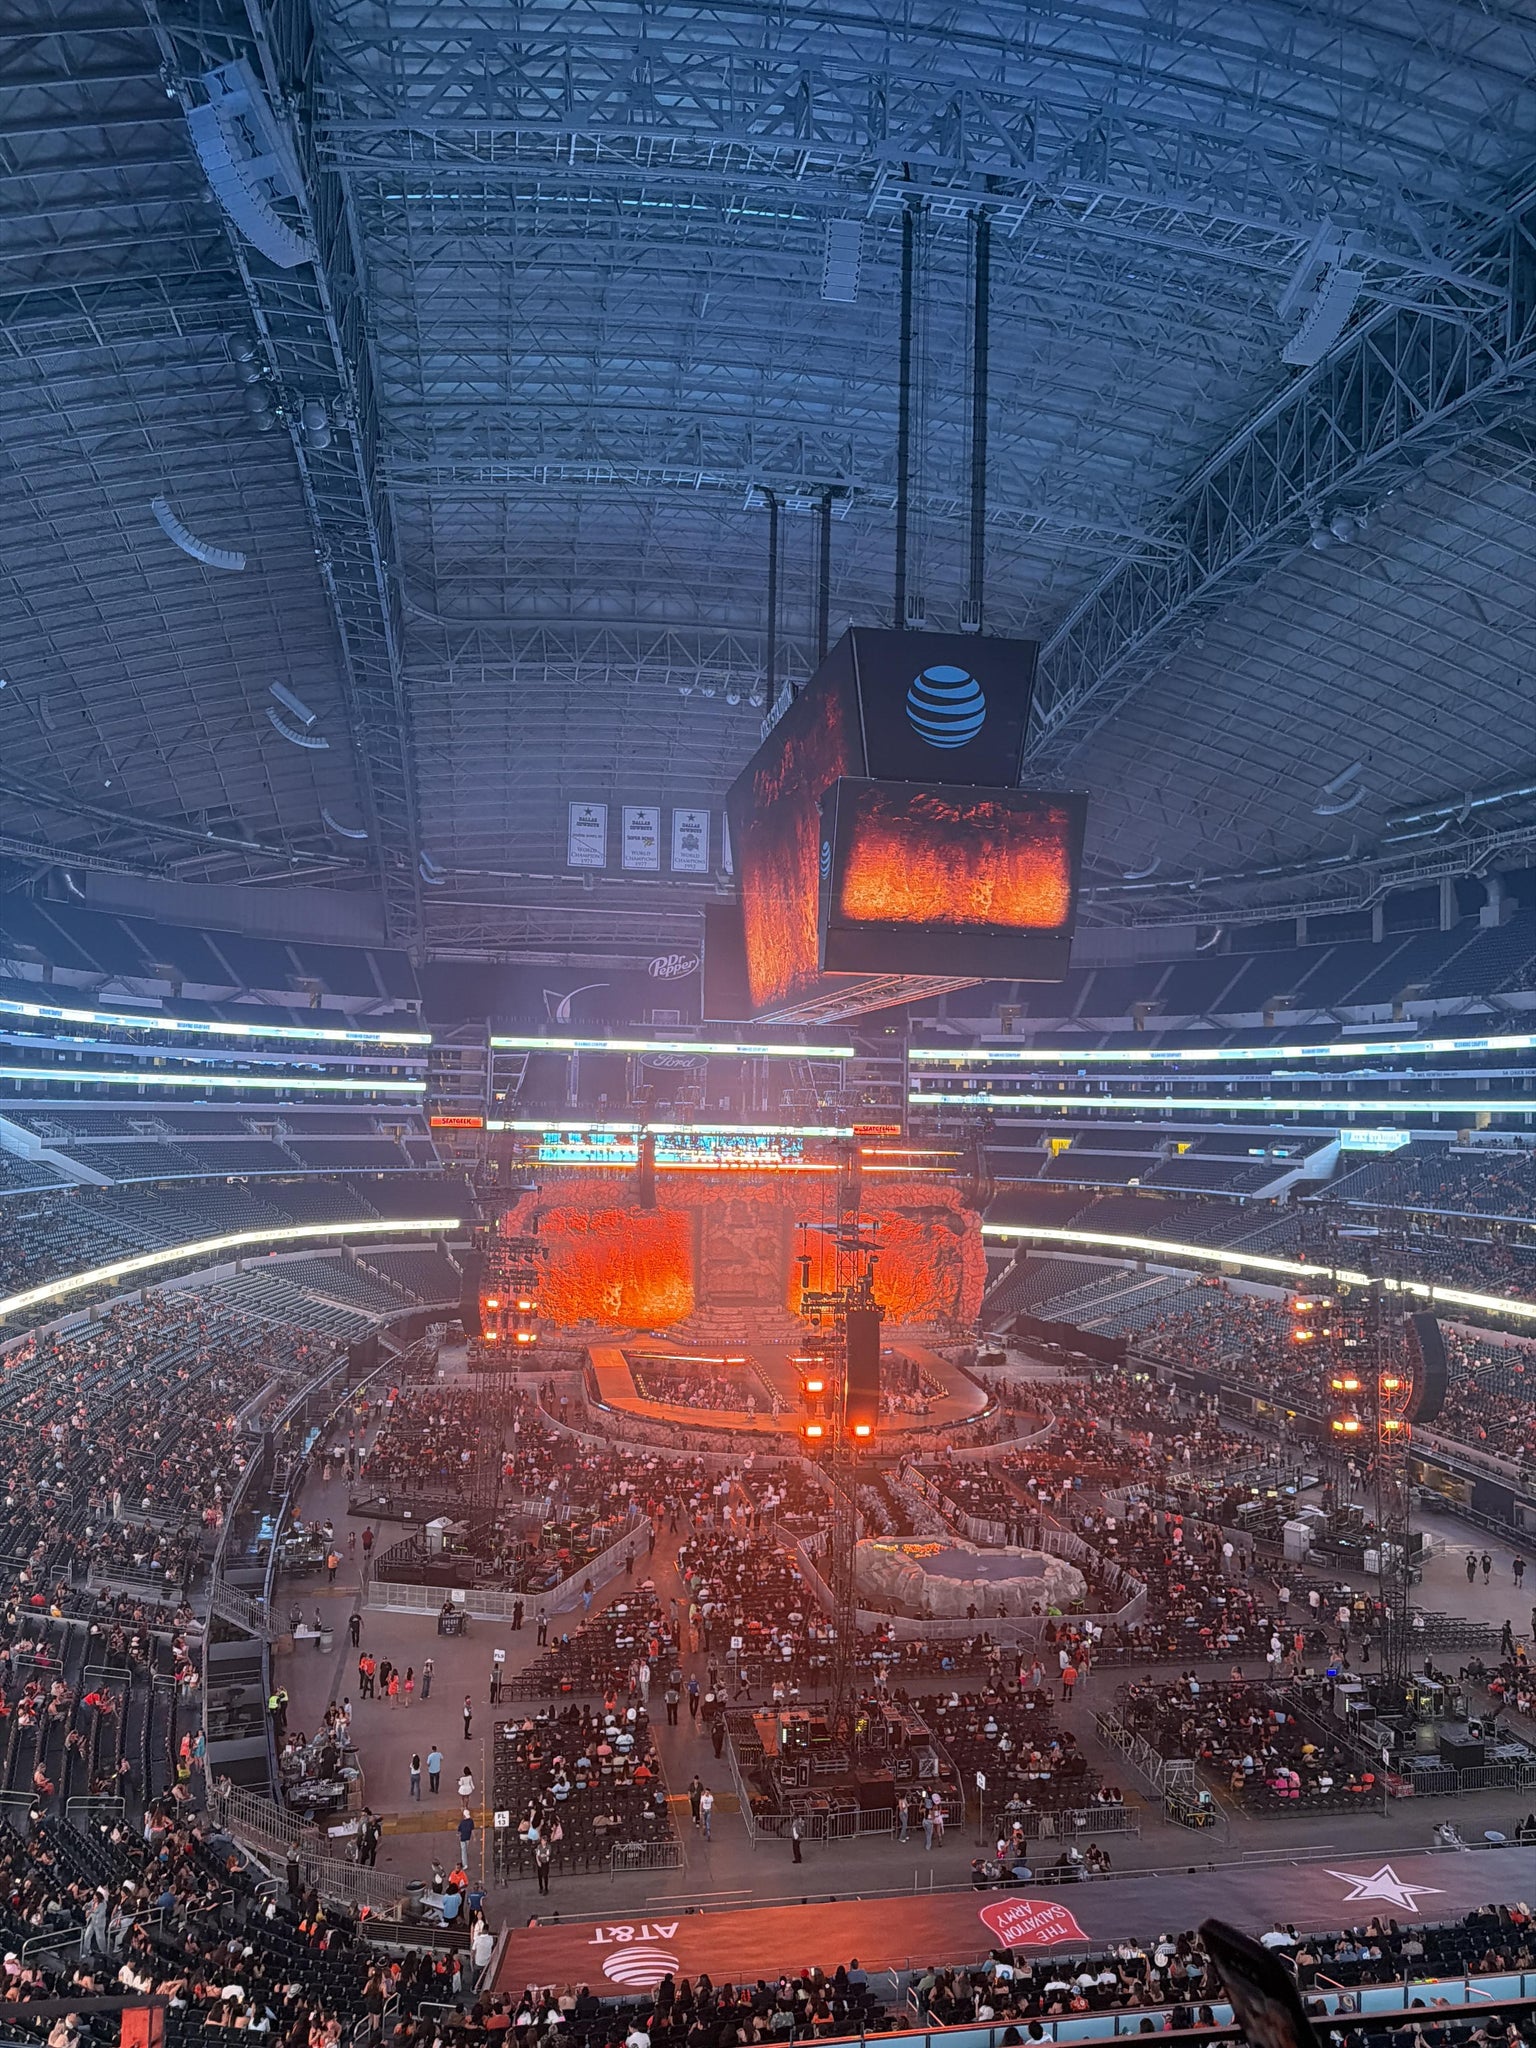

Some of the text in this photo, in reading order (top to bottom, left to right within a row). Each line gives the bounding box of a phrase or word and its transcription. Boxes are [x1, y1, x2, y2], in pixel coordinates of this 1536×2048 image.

[653, 957, 696, 977] Pepper
[668, 954, 686, 966] Dr
[653, 1053, 696, 1067] Ford
[997, 1902, 1032, 1928] ARMY
[1002, 1906, 1066, 1942] SALVATION
[588, 1922, 679, 1944] AT&T
[1036, 1923, 1068, 1941] THE
